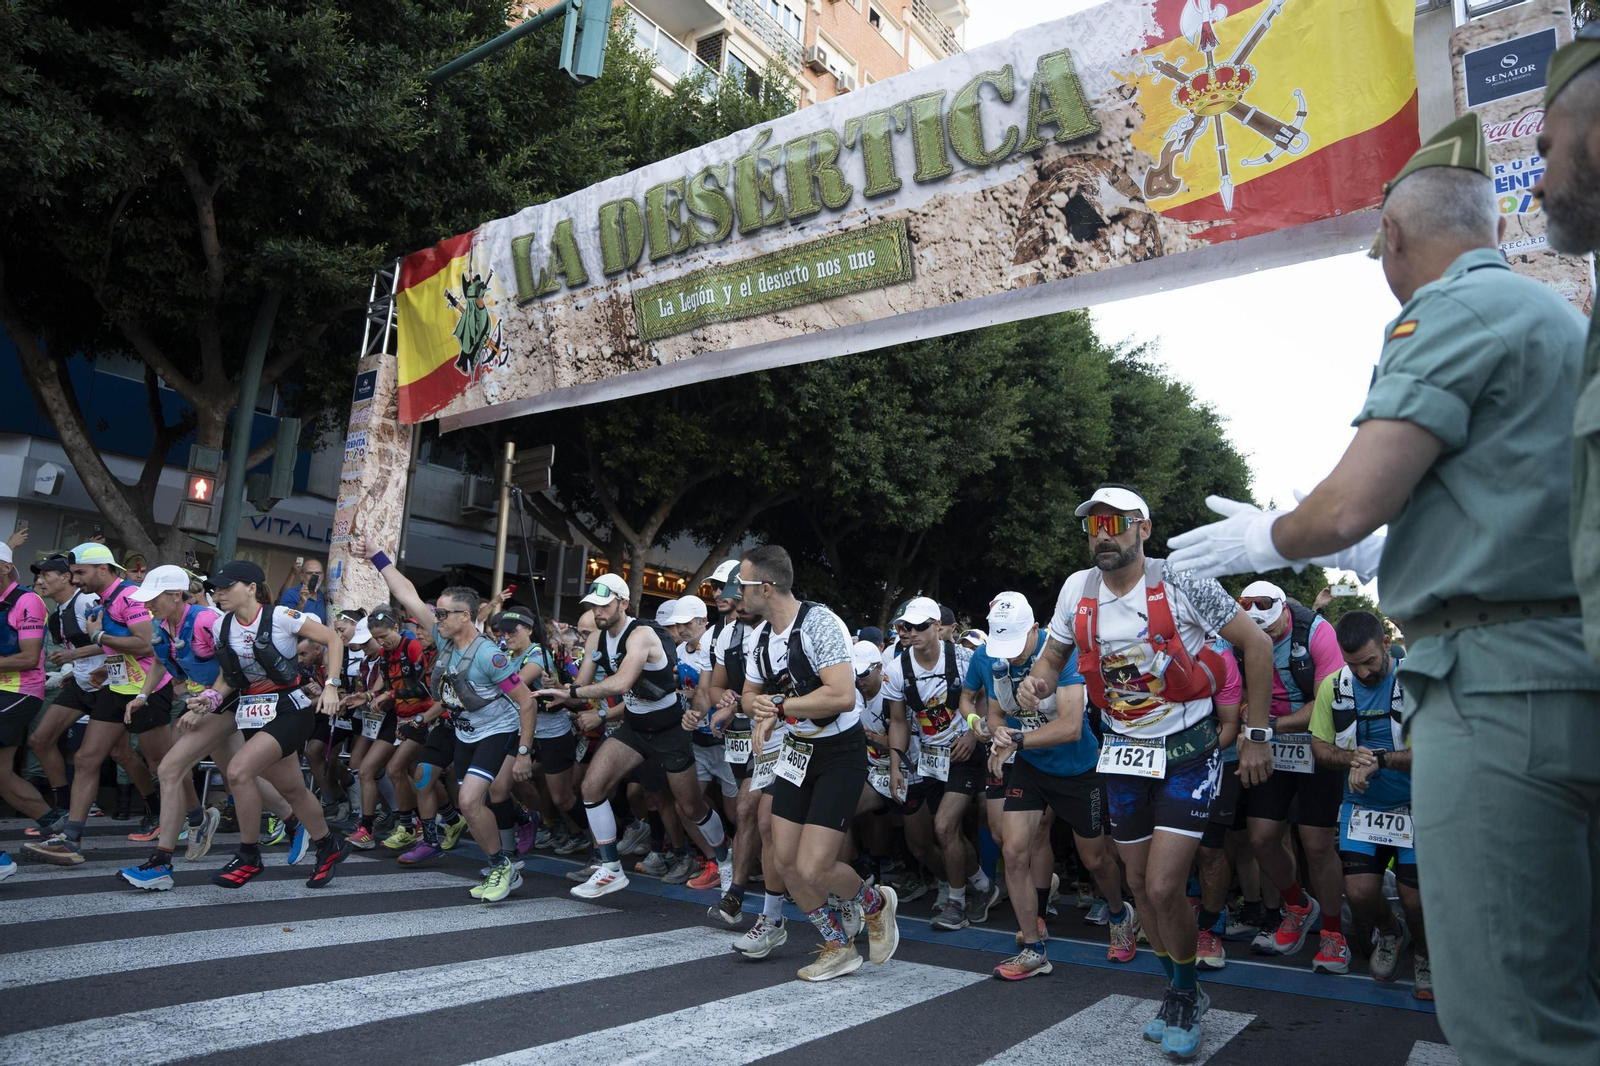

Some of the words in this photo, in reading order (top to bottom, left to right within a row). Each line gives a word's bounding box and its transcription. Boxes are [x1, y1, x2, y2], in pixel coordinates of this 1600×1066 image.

[1484, 63, 1537, 84] SENATOR
[1491, 79, 1508, 87] HOTELS
[1512, 73, 1532, 81] RESORTS
[1482, 109, 1546, 138] oca-Col
[1494, 156, 1541, 174] RUP
[510, 218, 589, 304] LA
[598, 47, 1102, 277] DESÉRTICA
[1494, 167, 1545, 194] ENT
[1498, 194, 1542, 214] OD
[657, 297, 675, 318] La
[678, 284, 716, 313] Legión
[722, 284, 733, 305] y
[739, 275, 753, 298] el
[758, 266, 810, 293] desierto
[816, 259, 841, 279] nos
[848, 249, 876, 271] une
[346, 438, 366, 449] RENTA
[345, 448, 365, 459] TODO
[250, 516, 333, 543] VITAL
[246, 704, 271, 718] 1413
[730, 740, 749, 752] 4601
[1271, 743, 1305, 759] 1776
[787, 750, 807, 771] 4602
[1114, 747, 1155, 768] 1521
[1365, 812, 1406, 831] 1470
[1368, 835, 1388, 843] asisa
